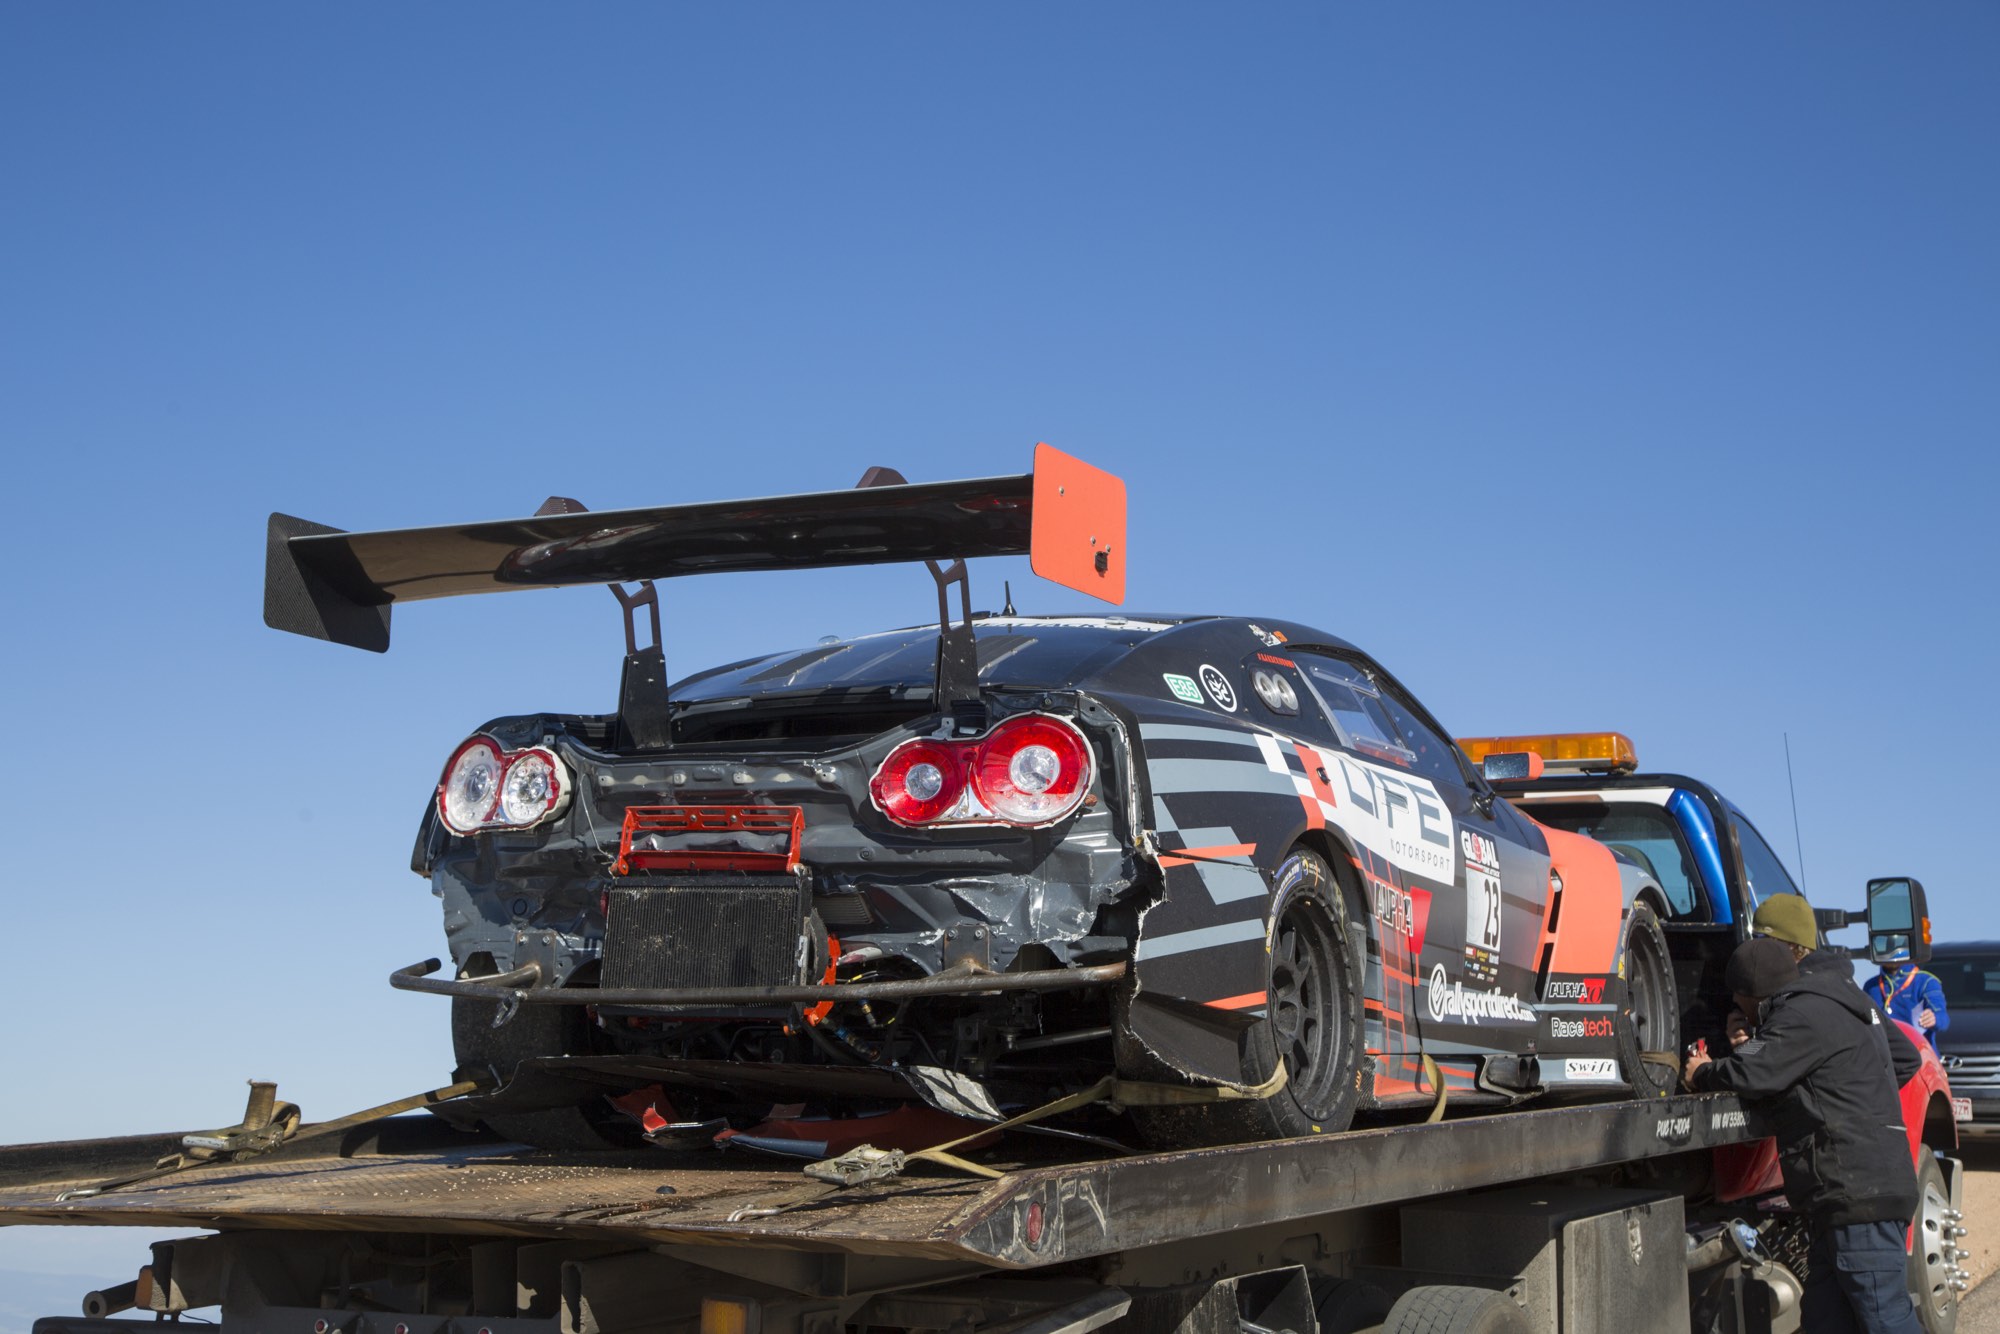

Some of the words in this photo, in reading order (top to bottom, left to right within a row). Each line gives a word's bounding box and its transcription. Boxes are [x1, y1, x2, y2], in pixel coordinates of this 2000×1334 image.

[1169, 679, 1199, 699] E85
[1339, 758, 1450, 849] LIFE
[1374, 880, 1413, 938] ALPHA
[1484, 878, 1499, 948] 23
[1548, 982, 1588, 999] ALPHA
[1567, 1061, 1613, 1074] Swift
